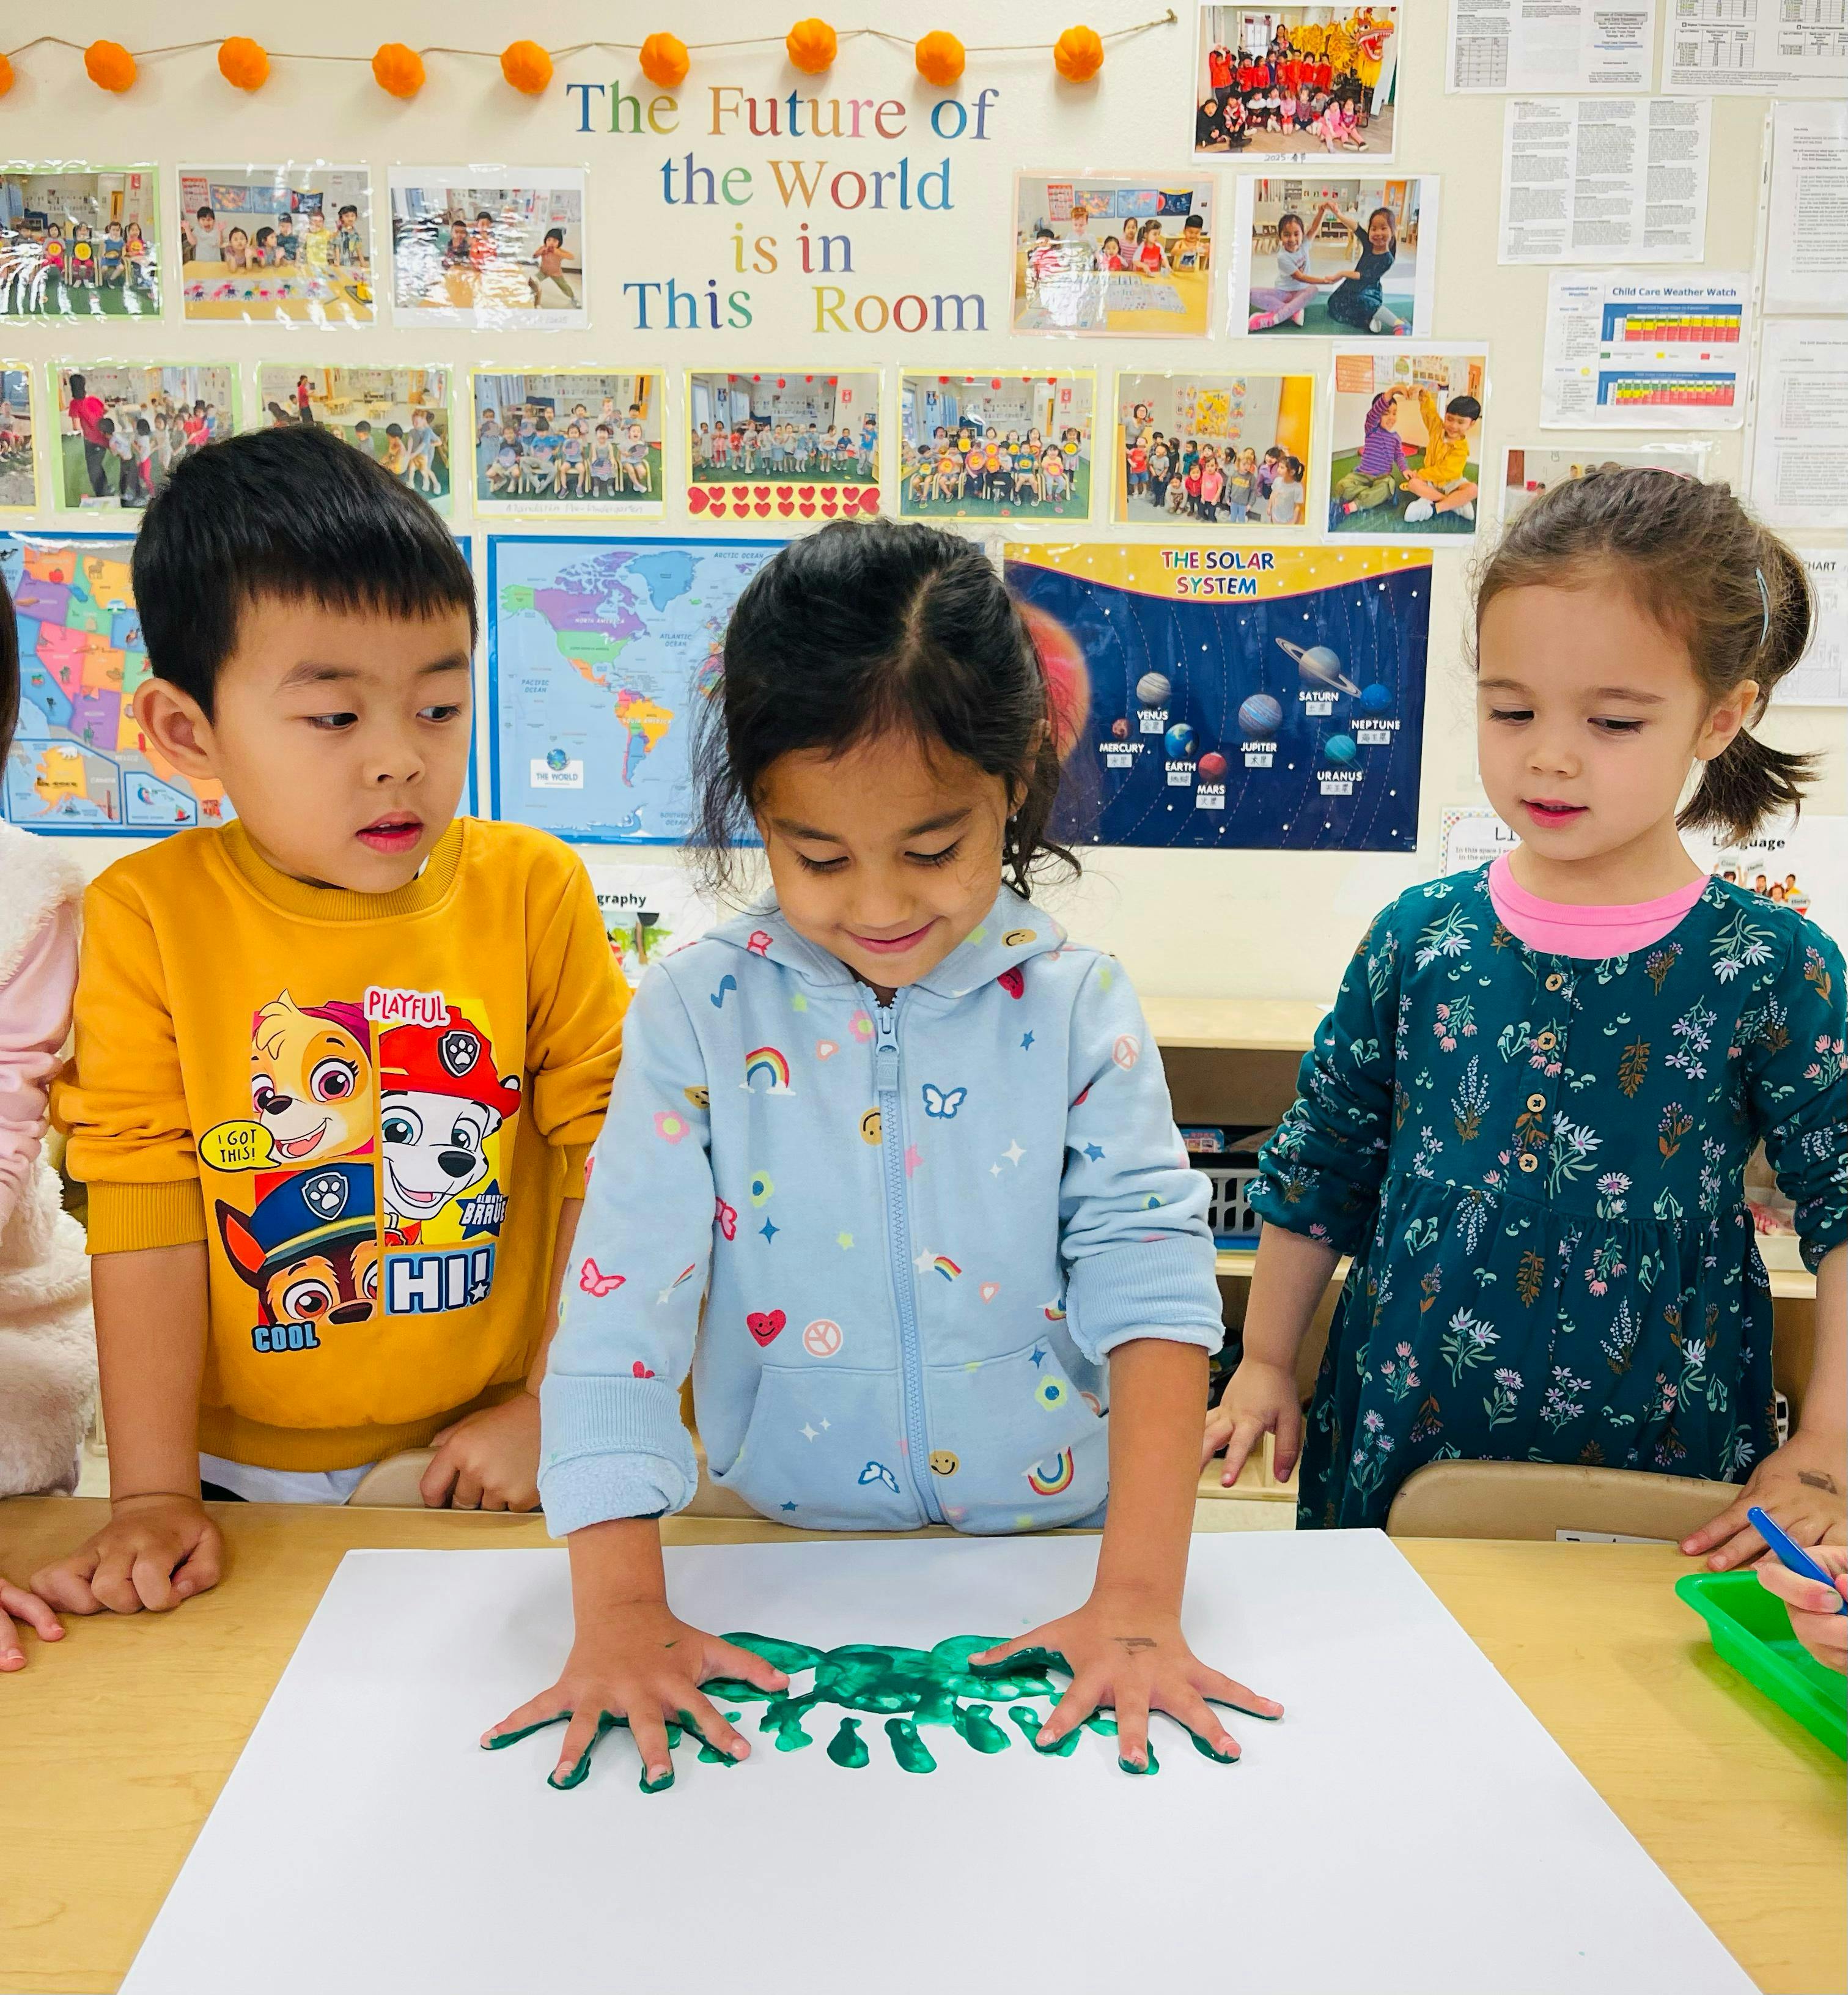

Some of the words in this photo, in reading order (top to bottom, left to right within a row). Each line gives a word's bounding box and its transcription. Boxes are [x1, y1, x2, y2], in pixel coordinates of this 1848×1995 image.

[566, 79, 680, 135] The
[708, 87, 907, 139] Future
[932, 89, 999, 140] of
[661, 152, 753, 205] the
[767, 157, 954, 210] World
[730, 222, 778, 274] is
[796, 223, 855, 273] in
[1613, 287, 1636, 297] Child
[1639, 288, 1660, 297] Care
[1663, 288, 1704, 297] Weather
[1706, 288, 1736, 297] Watch
[623, 278, 753, 330] This
[812, 286, 988, 333] Room
[1161, 551, 1199, 570] THE
[1206, 551, 1275, 572] SOLAR
[1805, 561, 1836, 571] HART
[1176, 577, 1257, 596] SYSTEM
[1299, 691, 1339, 702] SATURN
[1137, 710, 1168, 720] VENUS
[1352, 720, 1401, 730] NEPTUNE
[1099, 743, 1144, 753] MERCURY
[1240, 742, 1277, 753] JUPITER
[1165, 762, 1196, 771] EARTH
[551, 773, 578, 781] WORLD
[1317, 771, 1363, 782] URANUS
[1197, 784, 1225, 794] MARS
[597, 893, 646, 907] graphy
[369, 994, 447, 1023] PLAYFUL
[218, 1134, 222, 1145] I
[227, 1128, 256, 1145] GOT
[220, 1147, 256, 1162] THIS!
[461, 1201, 506, 1225] BRAVE
[391, 1251, 489, 1312] HI!
[254, 1324, 317, 1351] COOL
